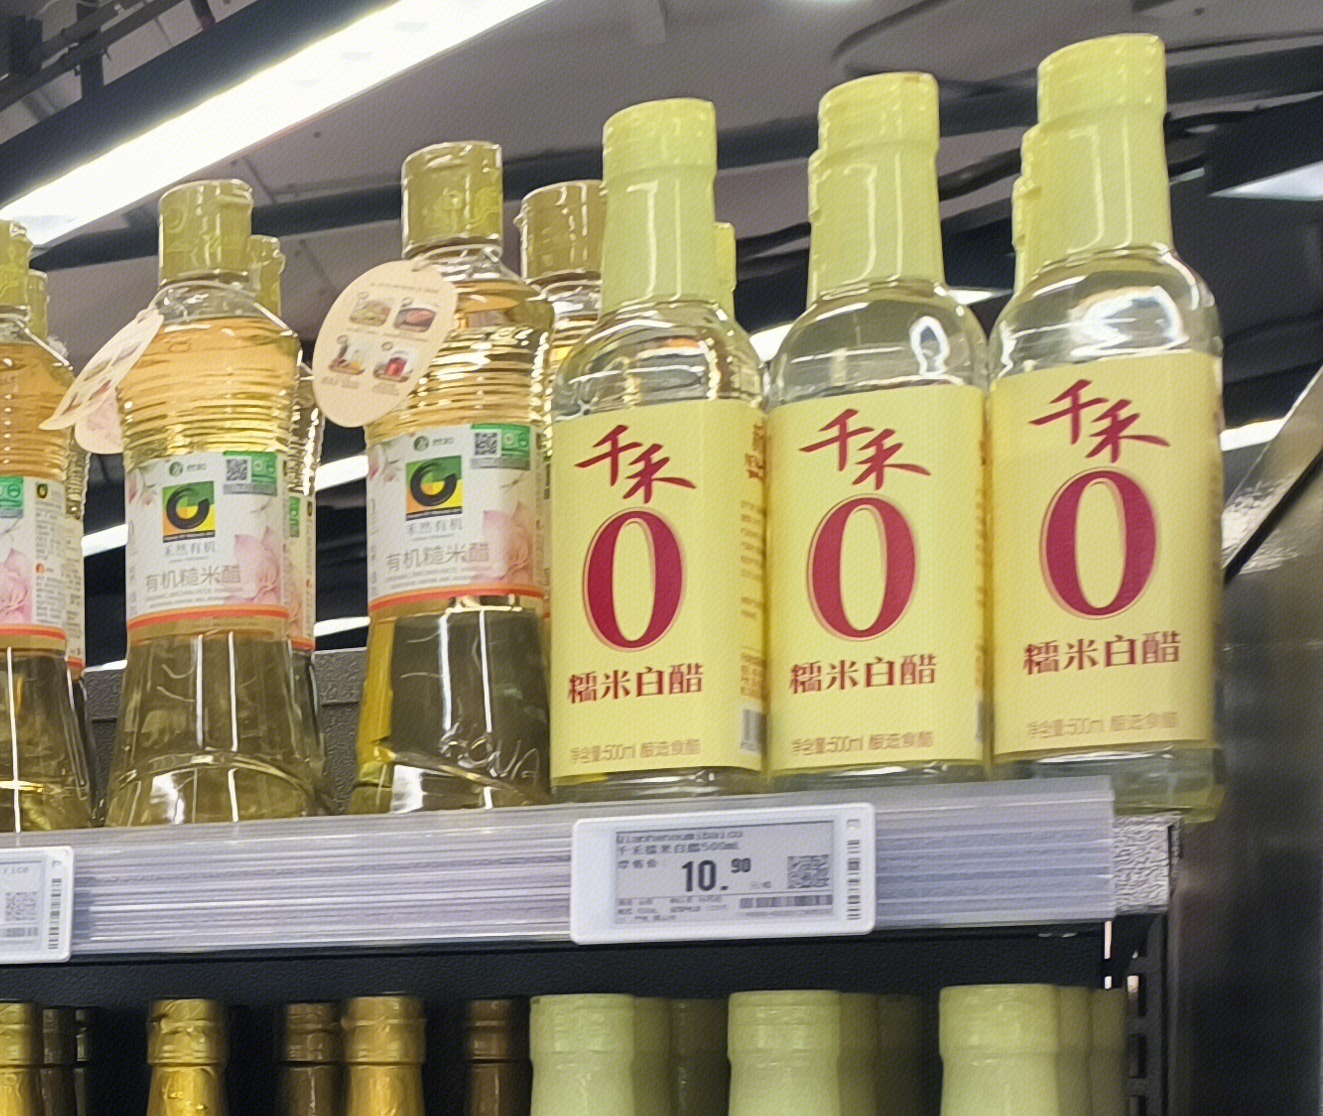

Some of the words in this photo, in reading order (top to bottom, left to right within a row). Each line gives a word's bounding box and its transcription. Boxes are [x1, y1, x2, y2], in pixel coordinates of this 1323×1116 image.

[799, 409, 930, 490] 千禾
[1029, 379, 1170, 463] 千禾
[575, 424, 696, 504] 千禾
[385, 541, 490, 573] 有机糙米醋
[806, 494, 917, 641] 0
[1039, 468, 1157, 620] 0
[143, 563, 243, 591] 有机糙米醋
[582, 508, 684, 652] 0
[568, 663, 704, 705] 糯米白醋
[789, 654, 937, 696] 糯米白醋
[1023, 631, 1180, 675] 糯米白醋
[682, 858, 751, 892] 10.90
